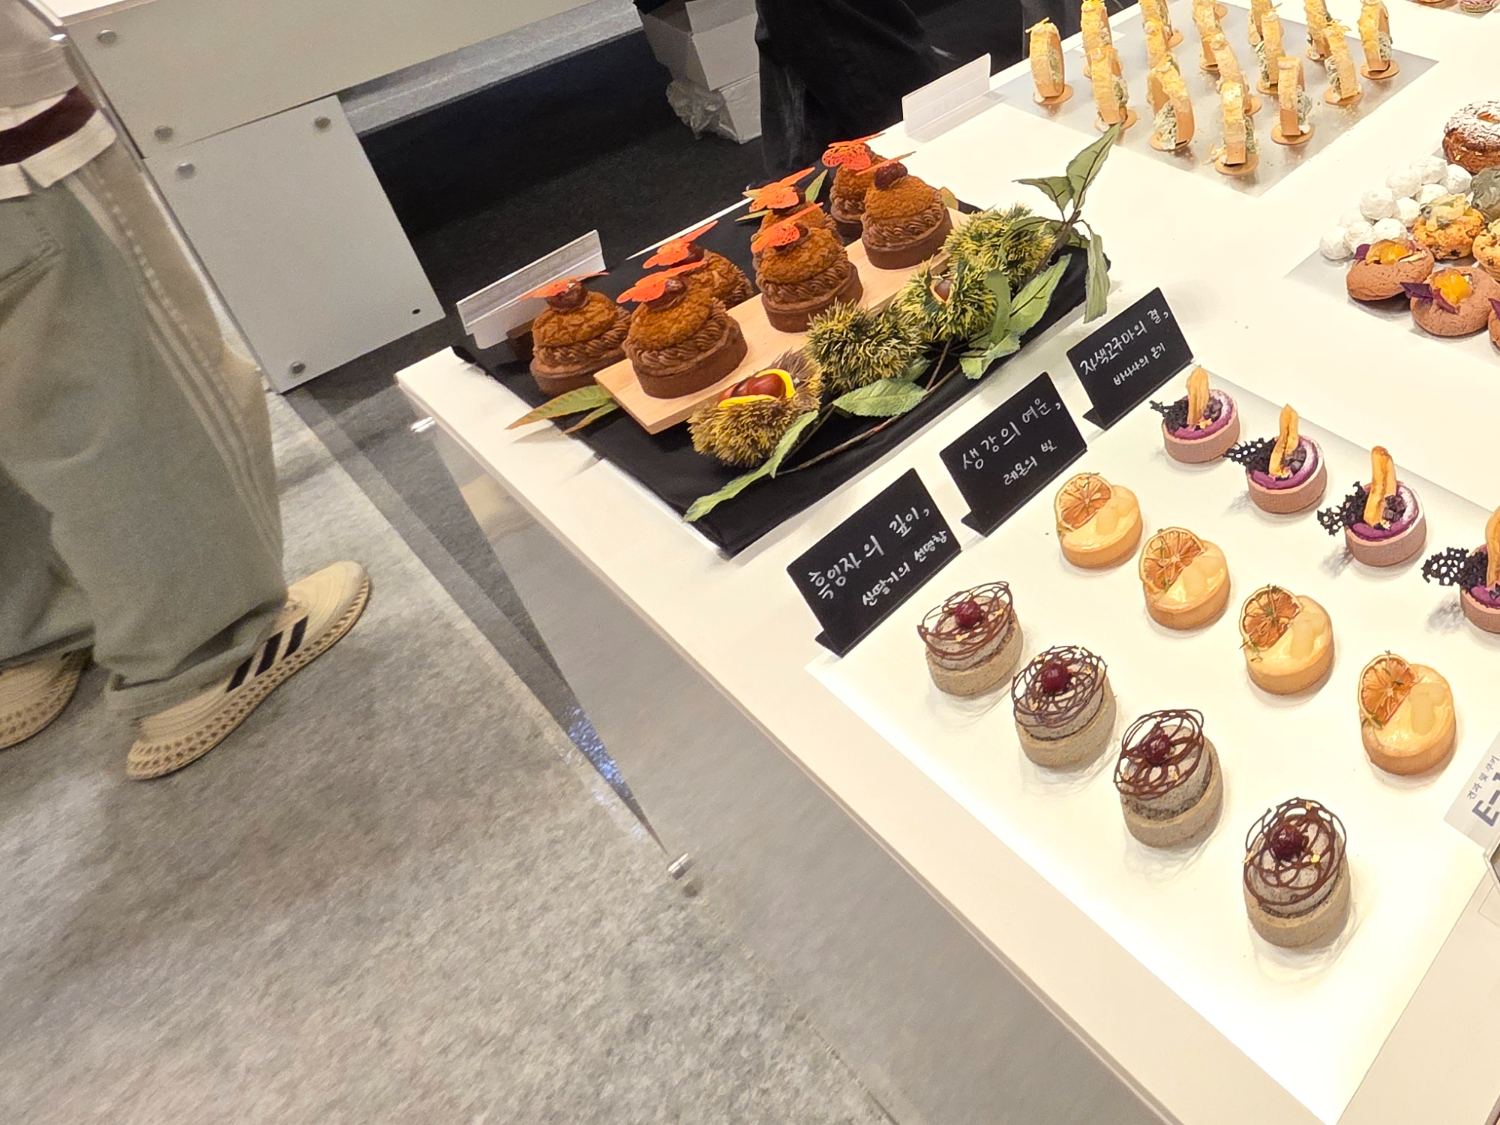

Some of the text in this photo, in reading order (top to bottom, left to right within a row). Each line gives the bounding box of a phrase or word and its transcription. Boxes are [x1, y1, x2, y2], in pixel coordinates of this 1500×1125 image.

[1080, 320, 1148, 375] 자색고구마의
[1113, 355, 1149, 386] 바나나의
[962, 422, 1021, 470] 생강의
[1003, 455, 1038, 485] 레몬의
[808, 535, 885, 600] 흑임자의
[862, 562, 911, 606] 산딸기의
[1467, 782, 1482, 800] 견과
